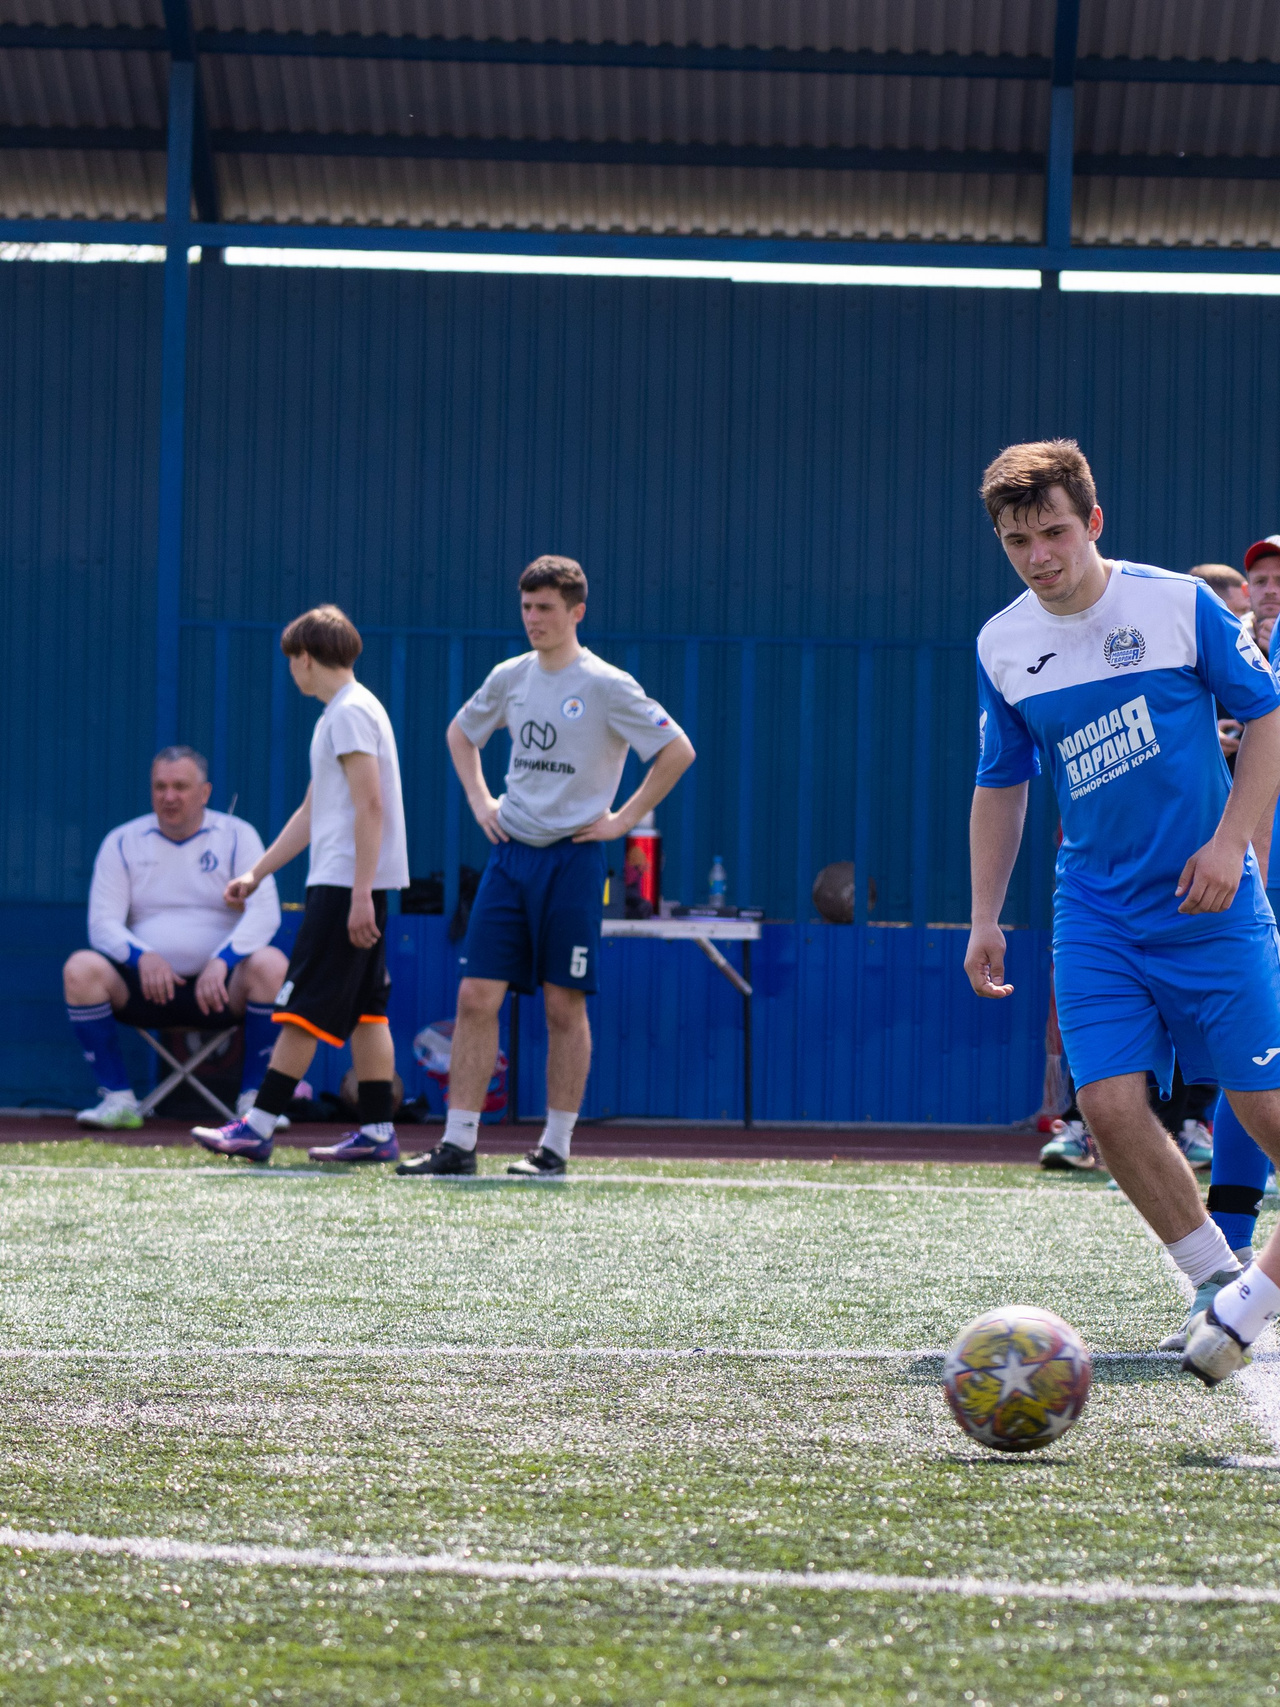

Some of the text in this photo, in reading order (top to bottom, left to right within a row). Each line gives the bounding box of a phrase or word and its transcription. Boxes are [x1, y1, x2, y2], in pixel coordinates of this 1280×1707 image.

[1070, 742, 1161, 801] ПРИМОРСКИЙ КРАЙ
[570, 945, 589, 978] 5
